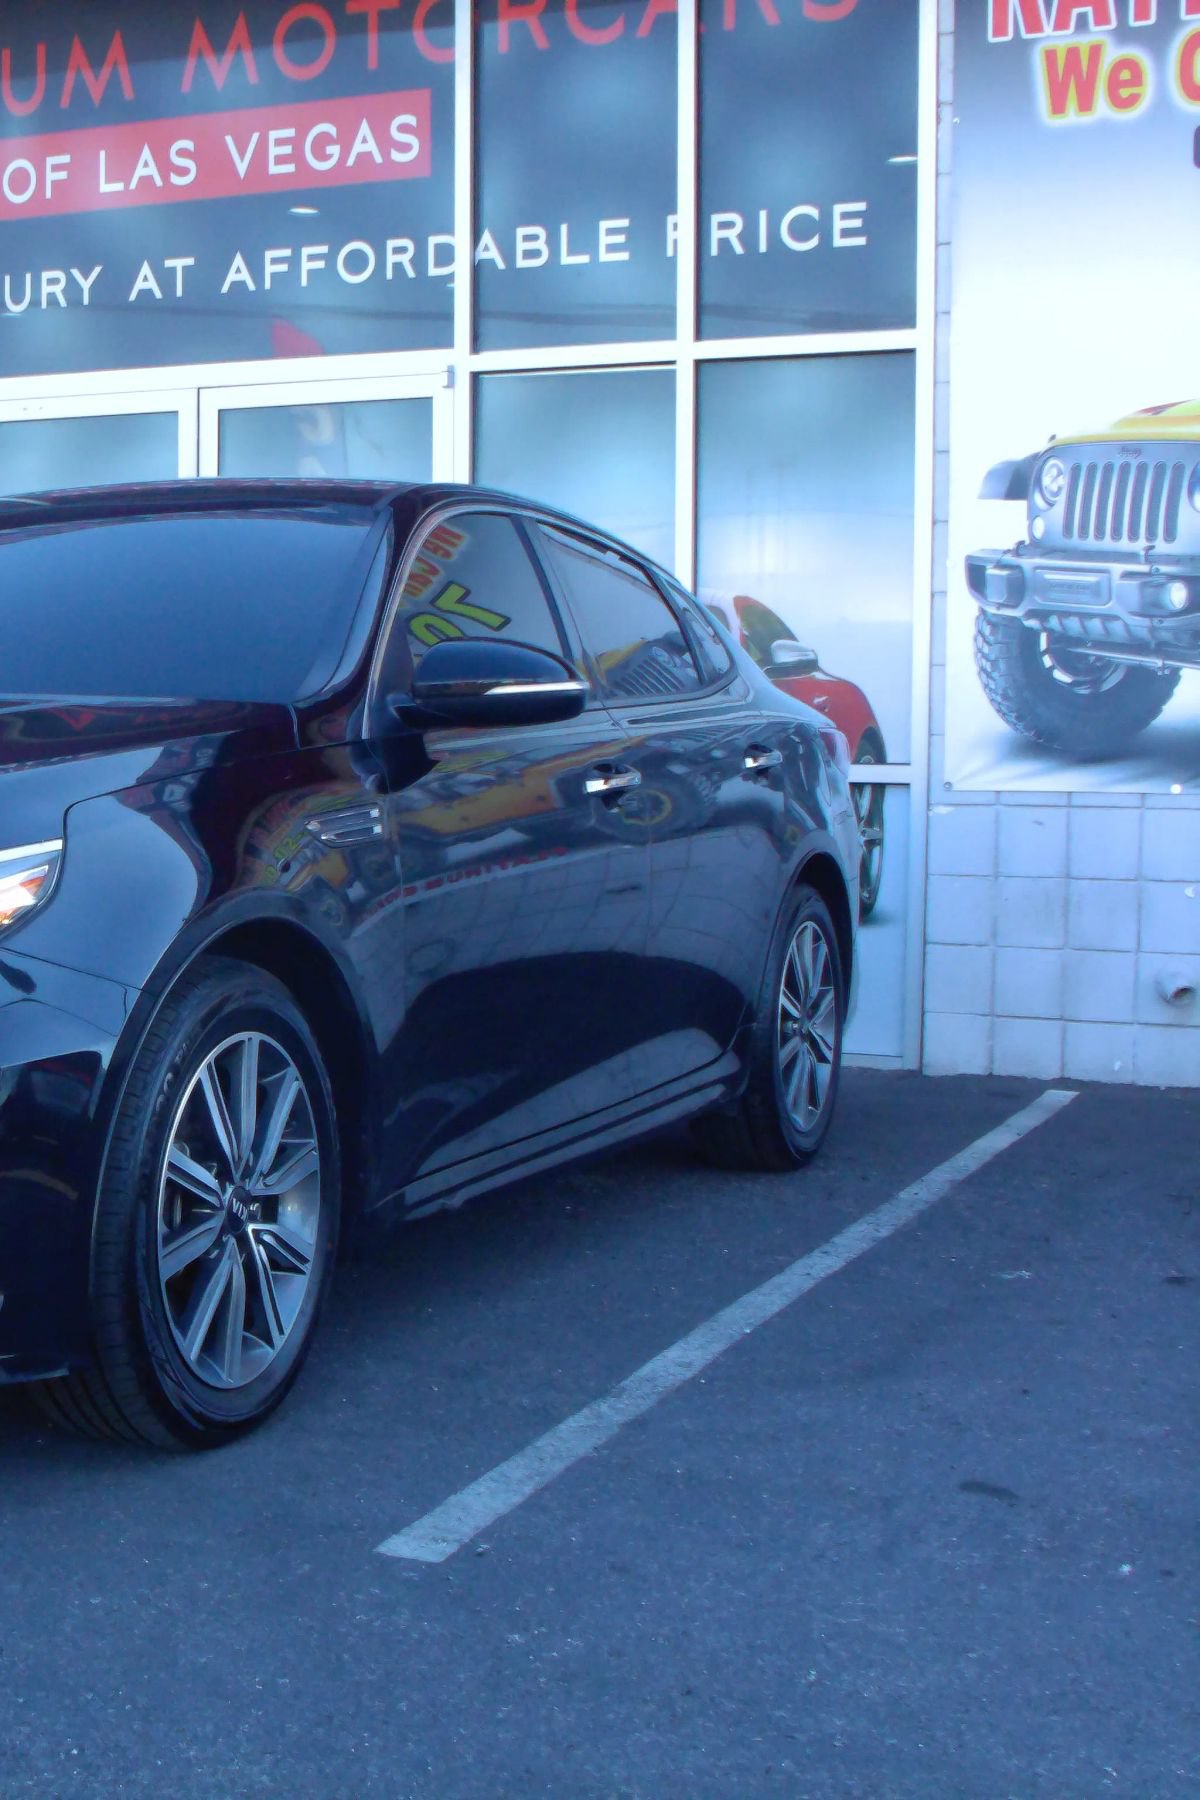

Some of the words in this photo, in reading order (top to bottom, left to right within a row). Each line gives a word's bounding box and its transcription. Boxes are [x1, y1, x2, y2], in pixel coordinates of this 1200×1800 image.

[181, 0, 859, 93] MOTORC
[1042, 40, 1146, 118] We
[2, 154, 71, 205] OF
[99, 138, 198, 194] LAS
[225, 113, 420, 181] VEGAS
[129, 257, 195, 302] AT
[221, 217, 631, 295] AFFORDABLE
